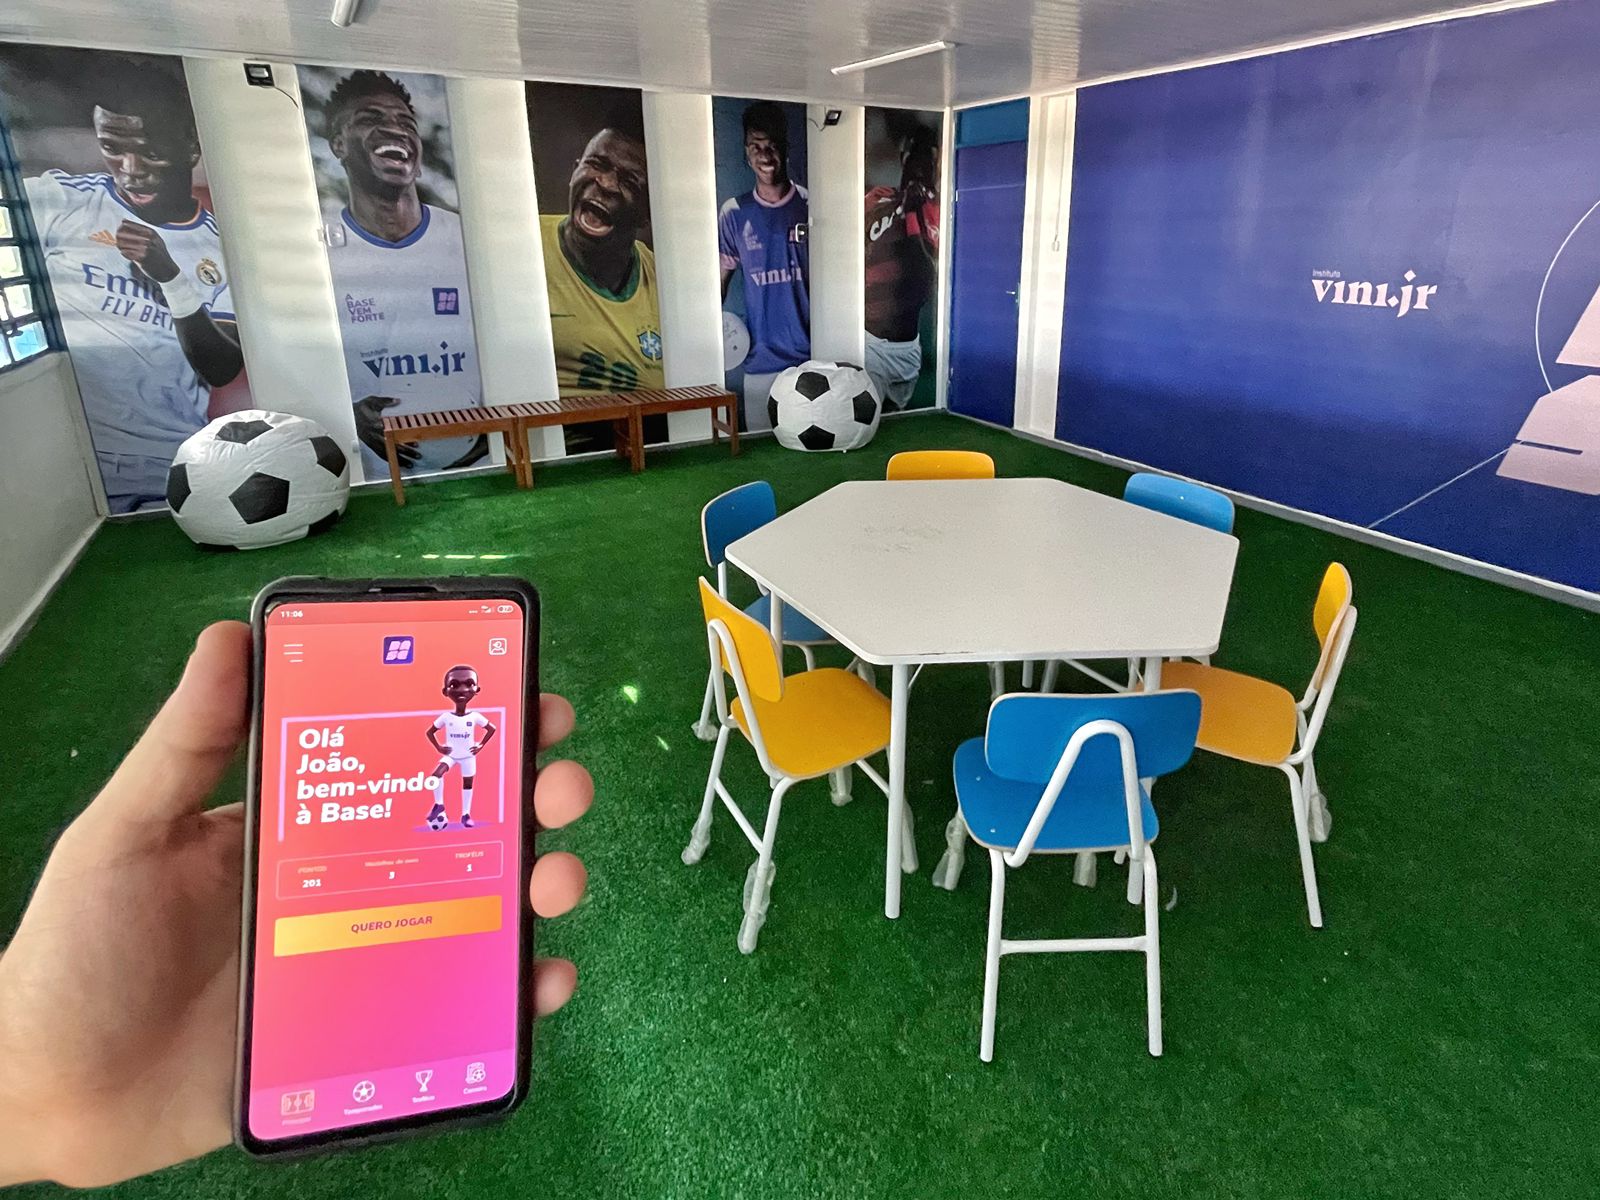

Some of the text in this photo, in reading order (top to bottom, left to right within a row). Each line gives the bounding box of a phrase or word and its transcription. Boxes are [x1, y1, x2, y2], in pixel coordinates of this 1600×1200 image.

[100, 295, 136, 317] FLY
[346, 297, 376, 309] BASE
[348, 306, 372, 317] VEM
[351, 311, 385, 324] FORTE
[280, 610, 304, 619] 11:06
[299, 725, 345, 749] Olá
[295, 751, 366, 775] João,
[296, 771, 440, 800] bem-vindo
[295, 797, 393, 825] à Base!
[350, 915, 433, 934] QUERO JOGAR
